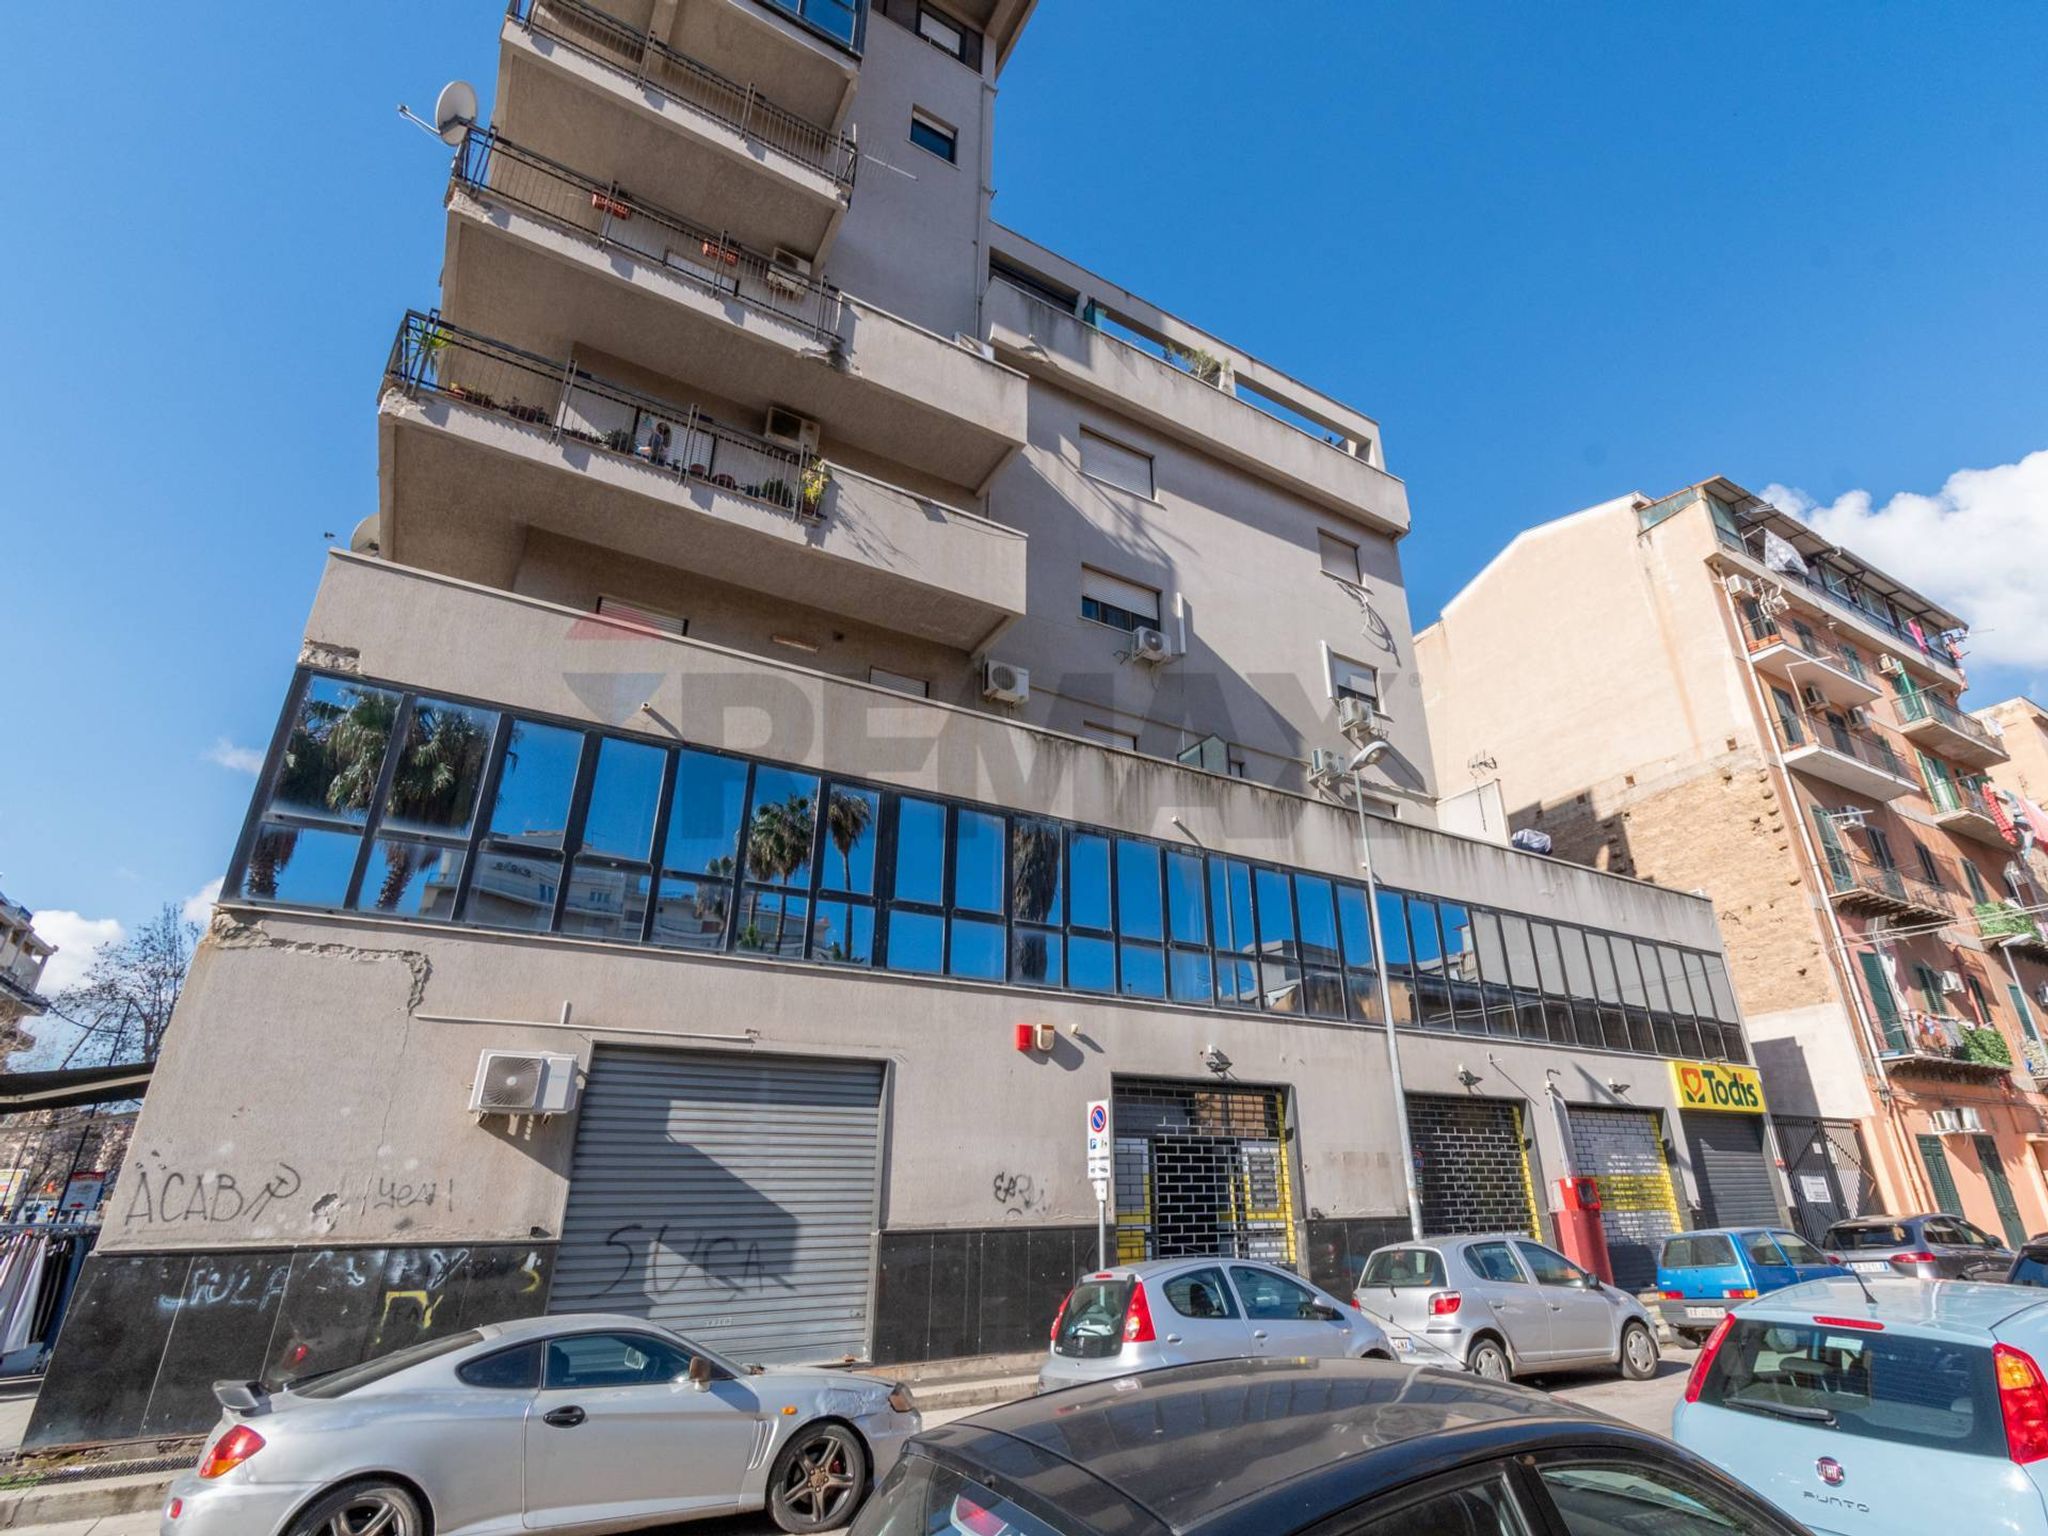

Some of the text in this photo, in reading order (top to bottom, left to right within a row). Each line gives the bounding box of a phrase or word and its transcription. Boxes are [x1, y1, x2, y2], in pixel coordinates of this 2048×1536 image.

[1701, 1069, 1759, 1107] Todis
[124, 1172, 244, 1226] ACAB
[1802, 1489, 1871, 1513] PUNTO
